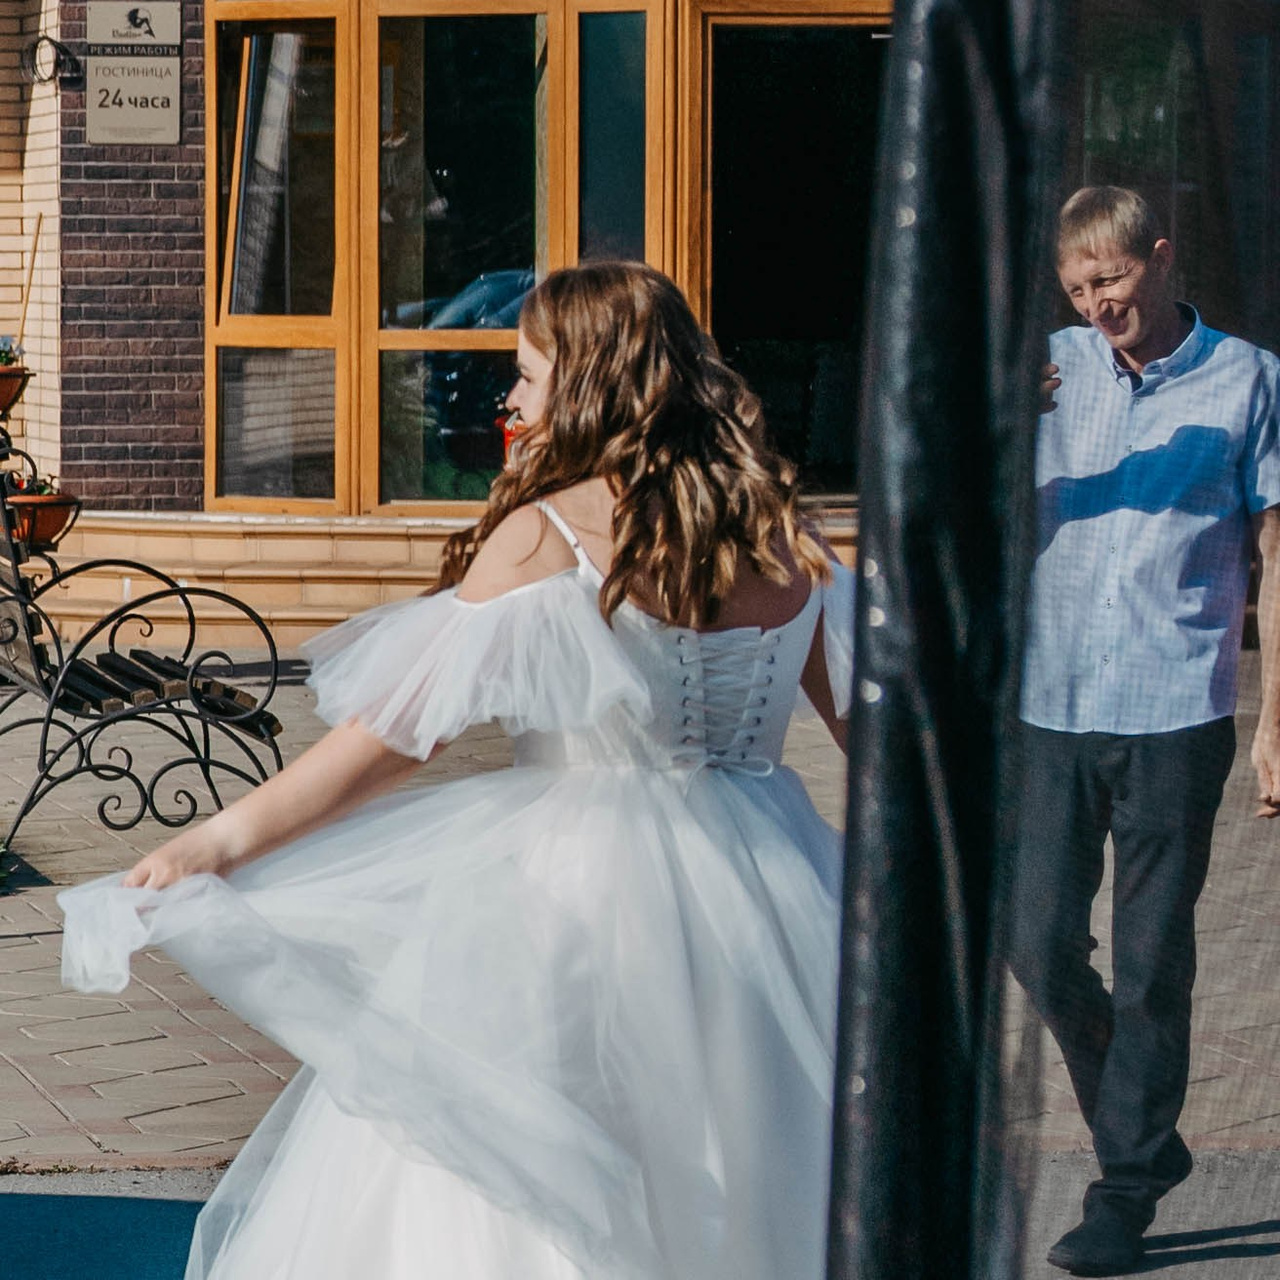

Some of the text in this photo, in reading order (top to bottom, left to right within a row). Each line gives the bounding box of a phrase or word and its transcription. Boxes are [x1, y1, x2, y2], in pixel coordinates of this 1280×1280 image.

[90, 45, 178, 55] РЕЖИМ РАБОТЫ
[95, 66, 172, 79] ГОСТИНИЦА
[98, 88, 171, 109] 24 часа
